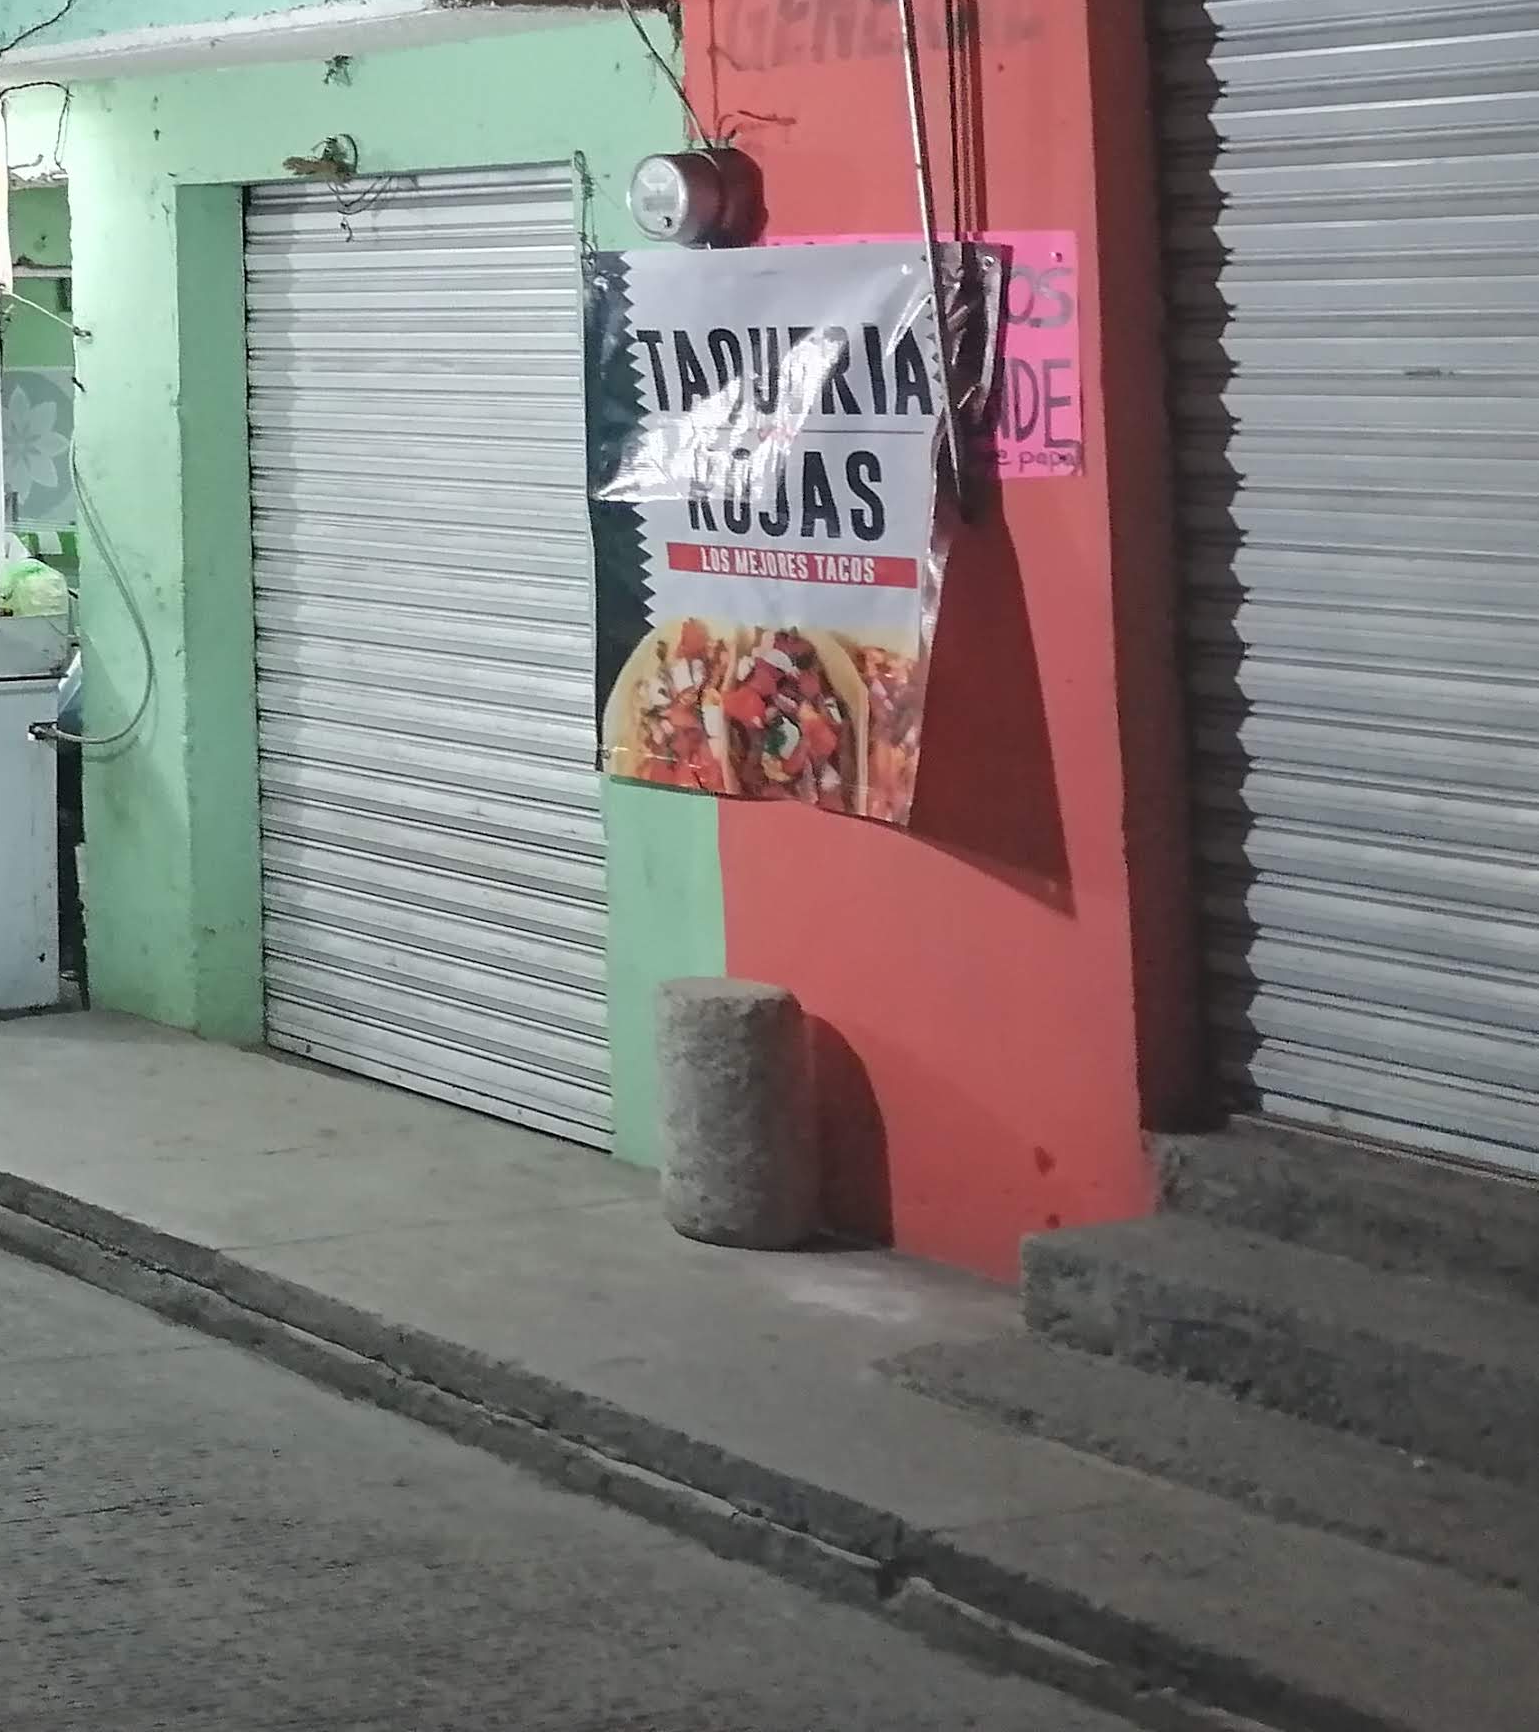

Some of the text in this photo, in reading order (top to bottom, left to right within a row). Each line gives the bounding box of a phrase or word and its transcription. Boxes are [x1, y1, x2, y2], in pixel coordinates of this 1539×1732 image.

[699, 546, 876, 583] LOS MEJORES TACOS
